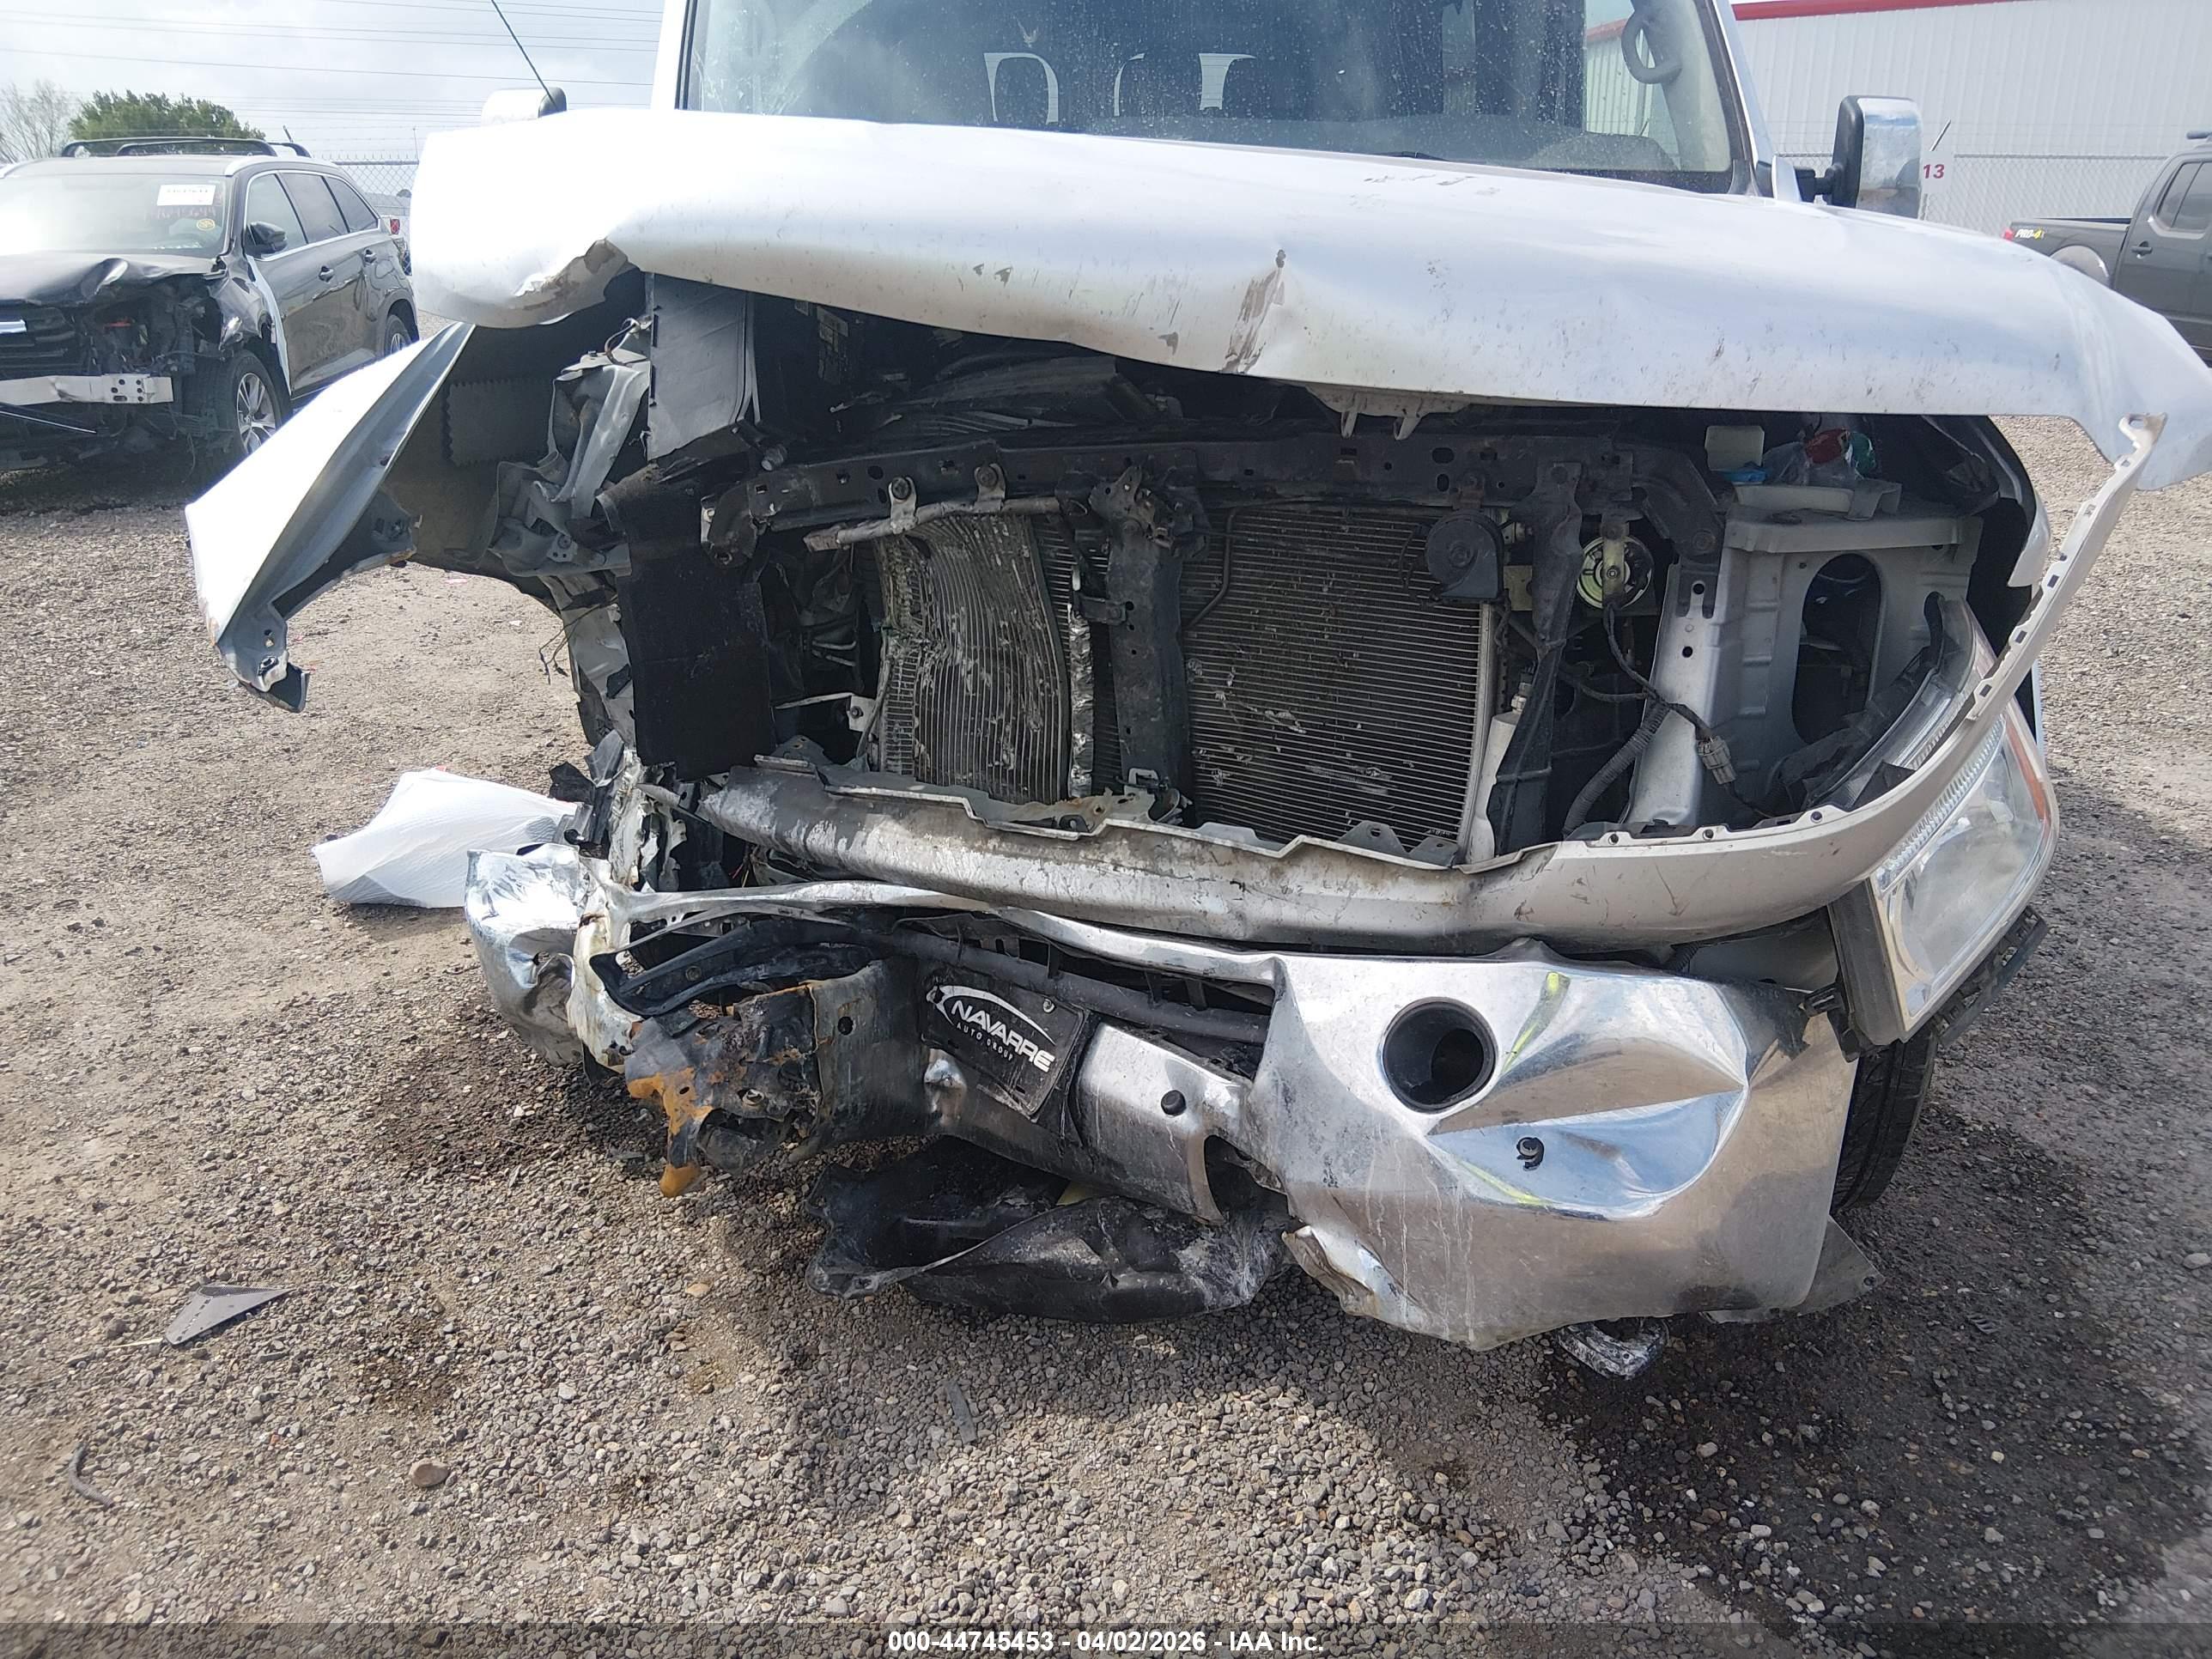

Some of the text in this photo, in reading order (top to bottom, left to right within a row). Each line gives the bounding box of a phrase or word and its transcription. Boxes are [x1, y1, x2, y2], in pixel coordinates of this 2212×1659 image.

[1923, 163, 1945, 179] 13
[951, 1000, 1055, 1073] NAVARRE
[956, 1023, 1015, 1061] AUTO GROUP
